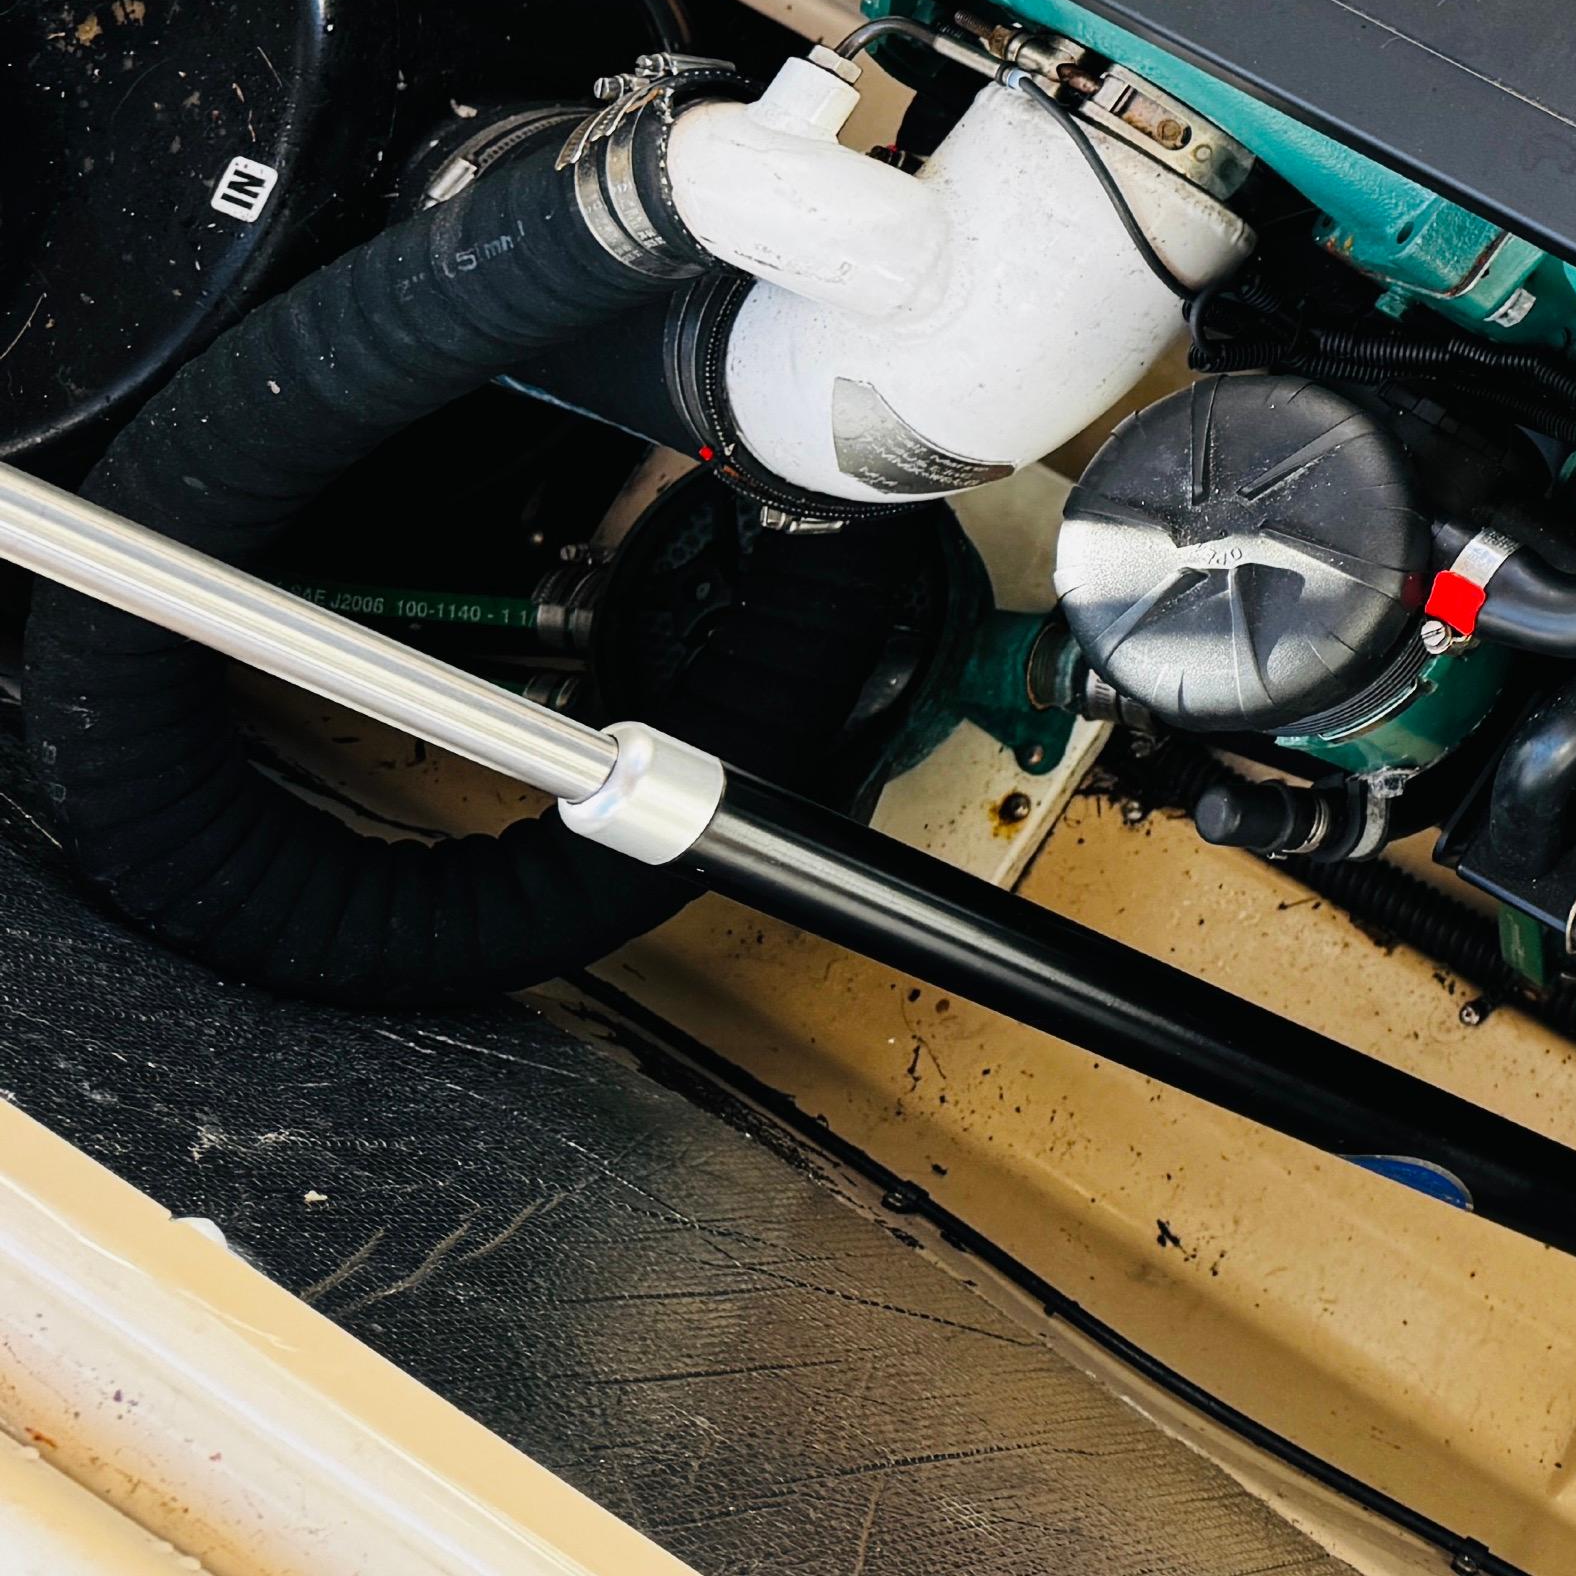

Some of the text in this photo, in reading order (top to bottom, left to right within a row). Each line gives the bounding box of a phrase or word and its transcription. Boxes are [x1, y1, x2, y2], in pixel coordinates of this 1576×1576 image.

[219, 167, 264, 212] IN
[397, 600, 481, 621] 100-1140
[501, 608, 509, 624] 1
